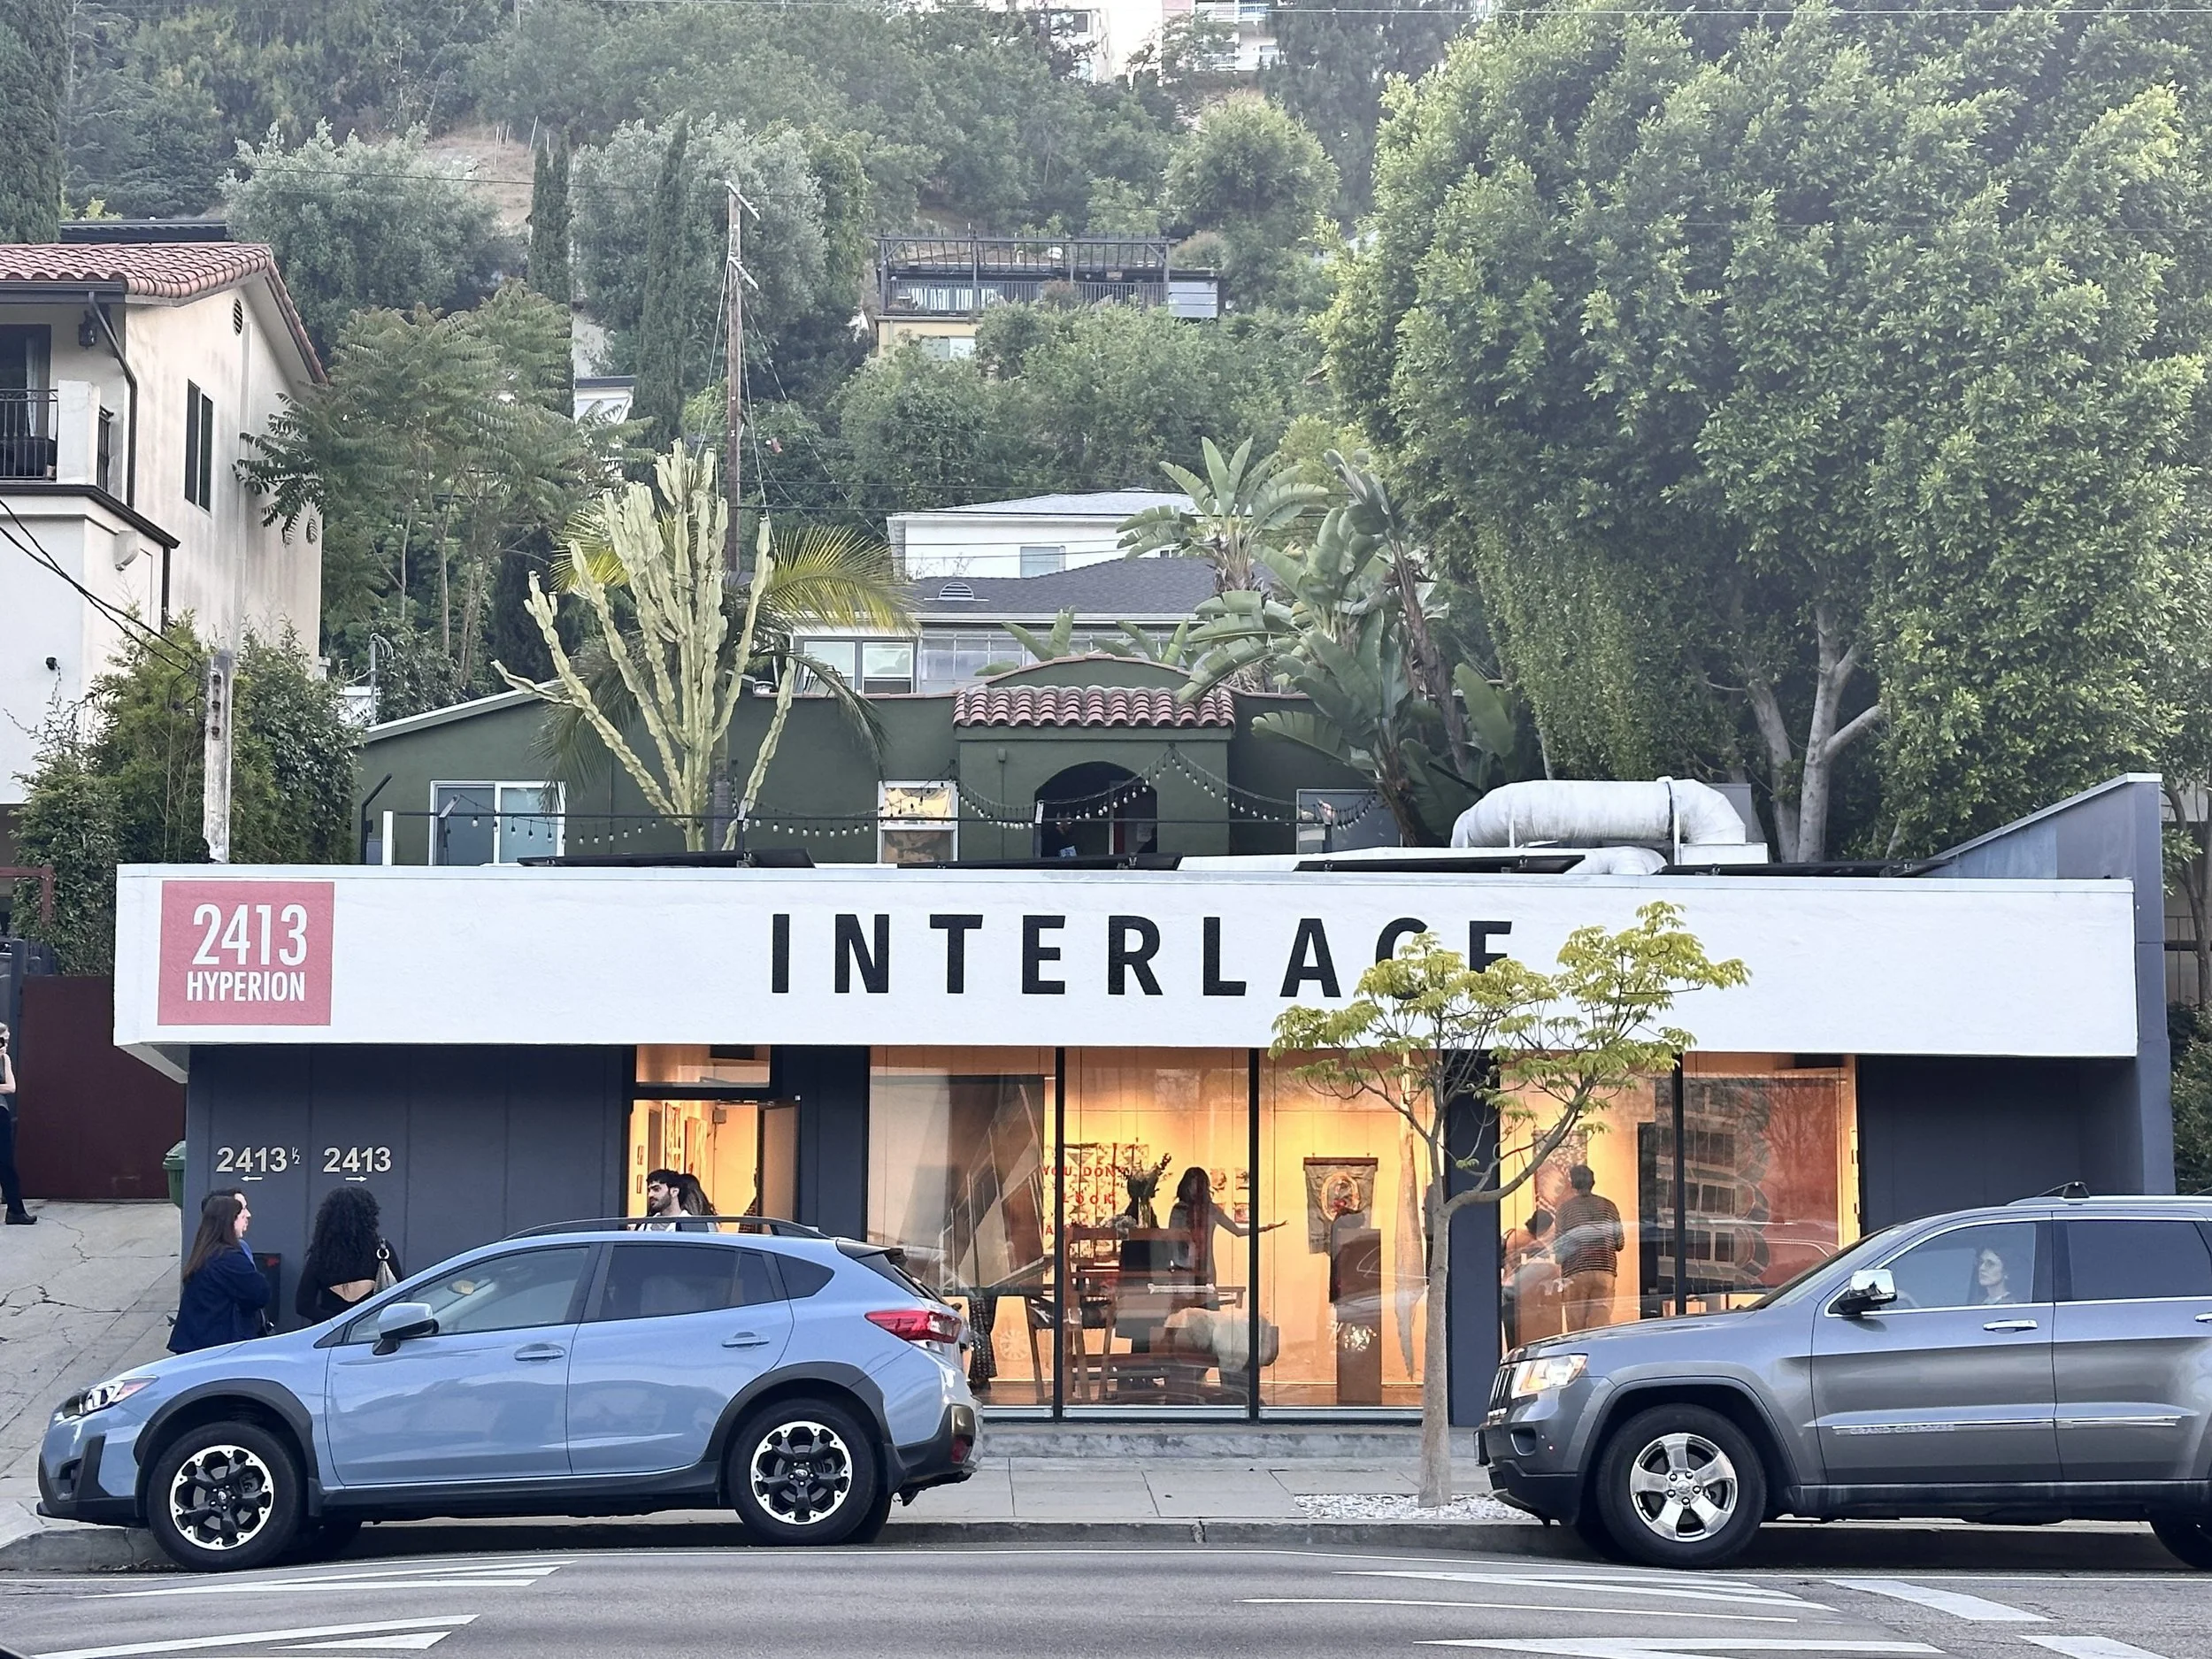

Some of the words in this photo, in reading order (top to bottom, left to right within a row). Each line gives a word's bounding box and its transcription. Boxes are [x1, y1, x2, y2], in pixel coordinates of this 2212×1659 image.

[192, 903, 308, 966] 2413
[772, 913, 1513, 1000] INTERLACE
[187, 971, 306, 1002] HYPERION
[323, 1147, 392, 1172] 2413
